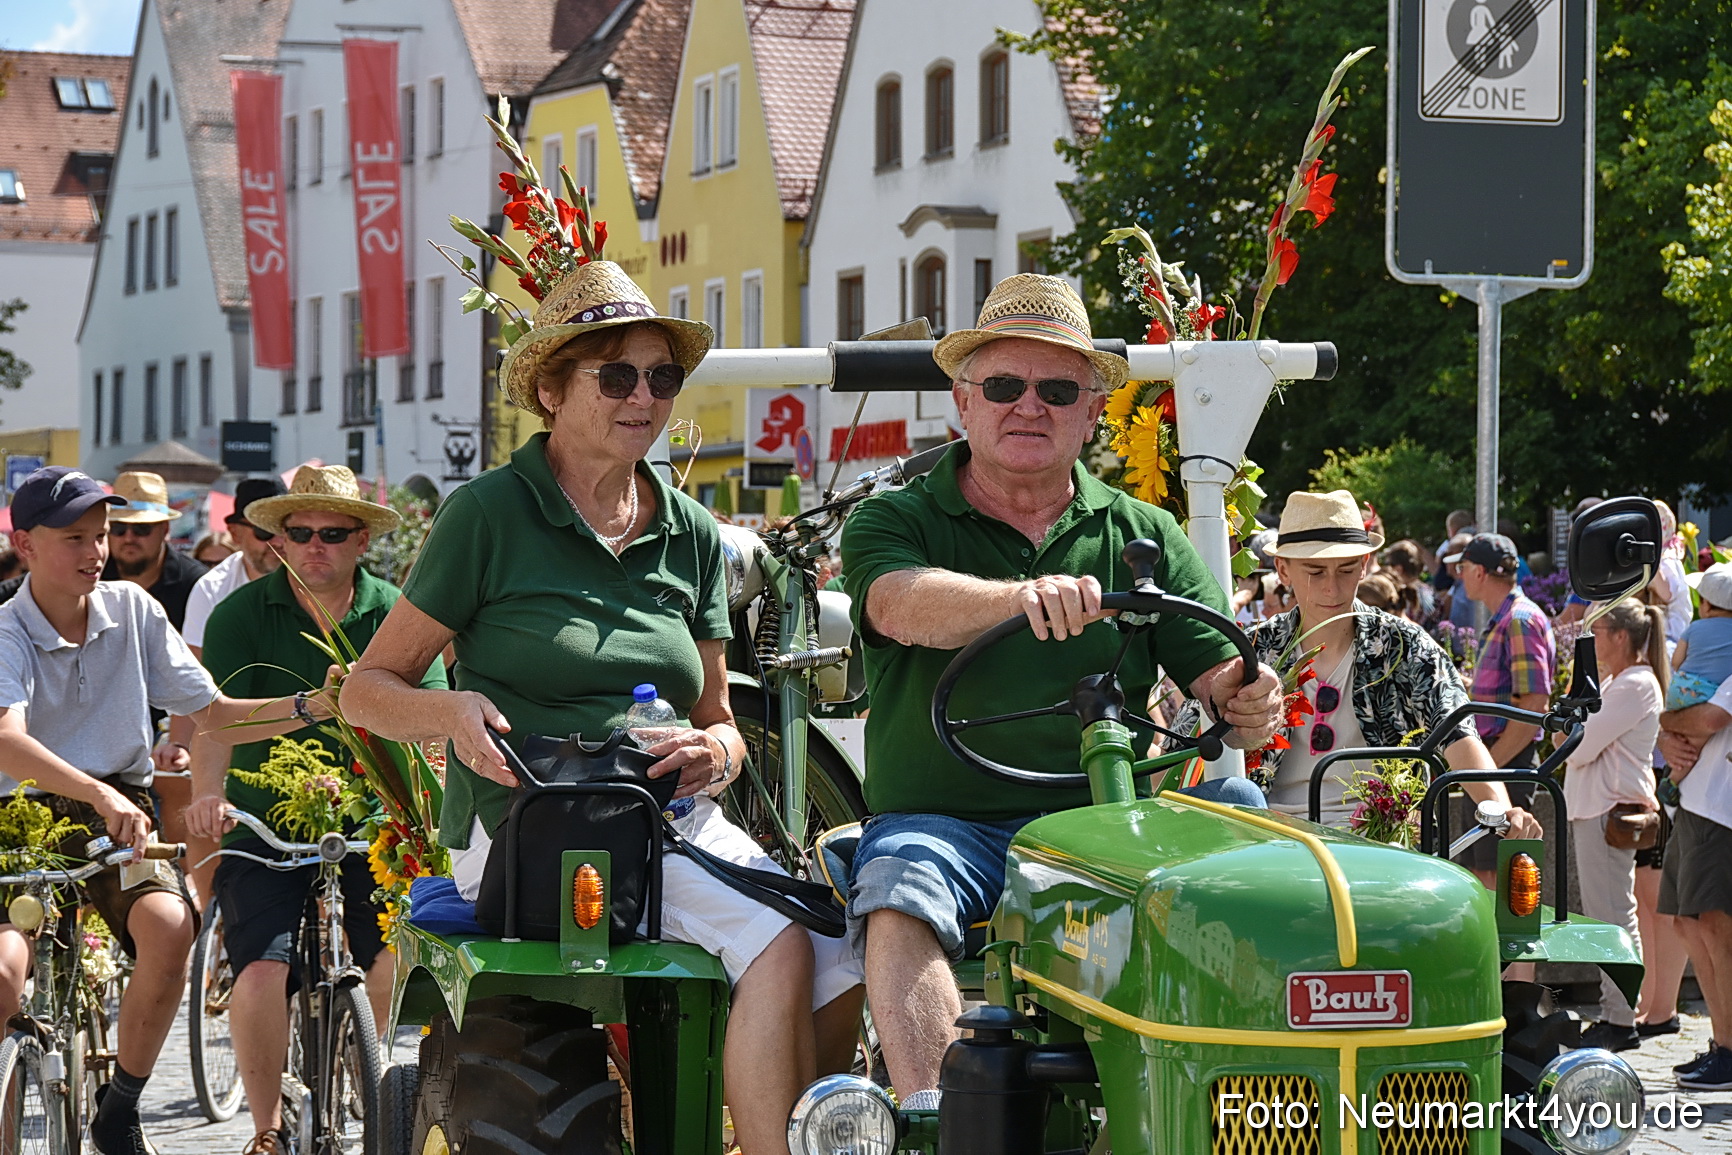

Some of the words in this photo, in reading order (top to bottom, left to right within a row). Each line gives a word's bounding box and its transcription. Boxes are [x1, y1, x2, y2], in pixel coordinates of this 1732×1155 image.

[1457, 85, 1526, 111] ZONE
[243, 168, 285, 275] SALE
[1062, 900, 1089, 960] Bautz
[1303, 975, 1398, 1022] Bautz
